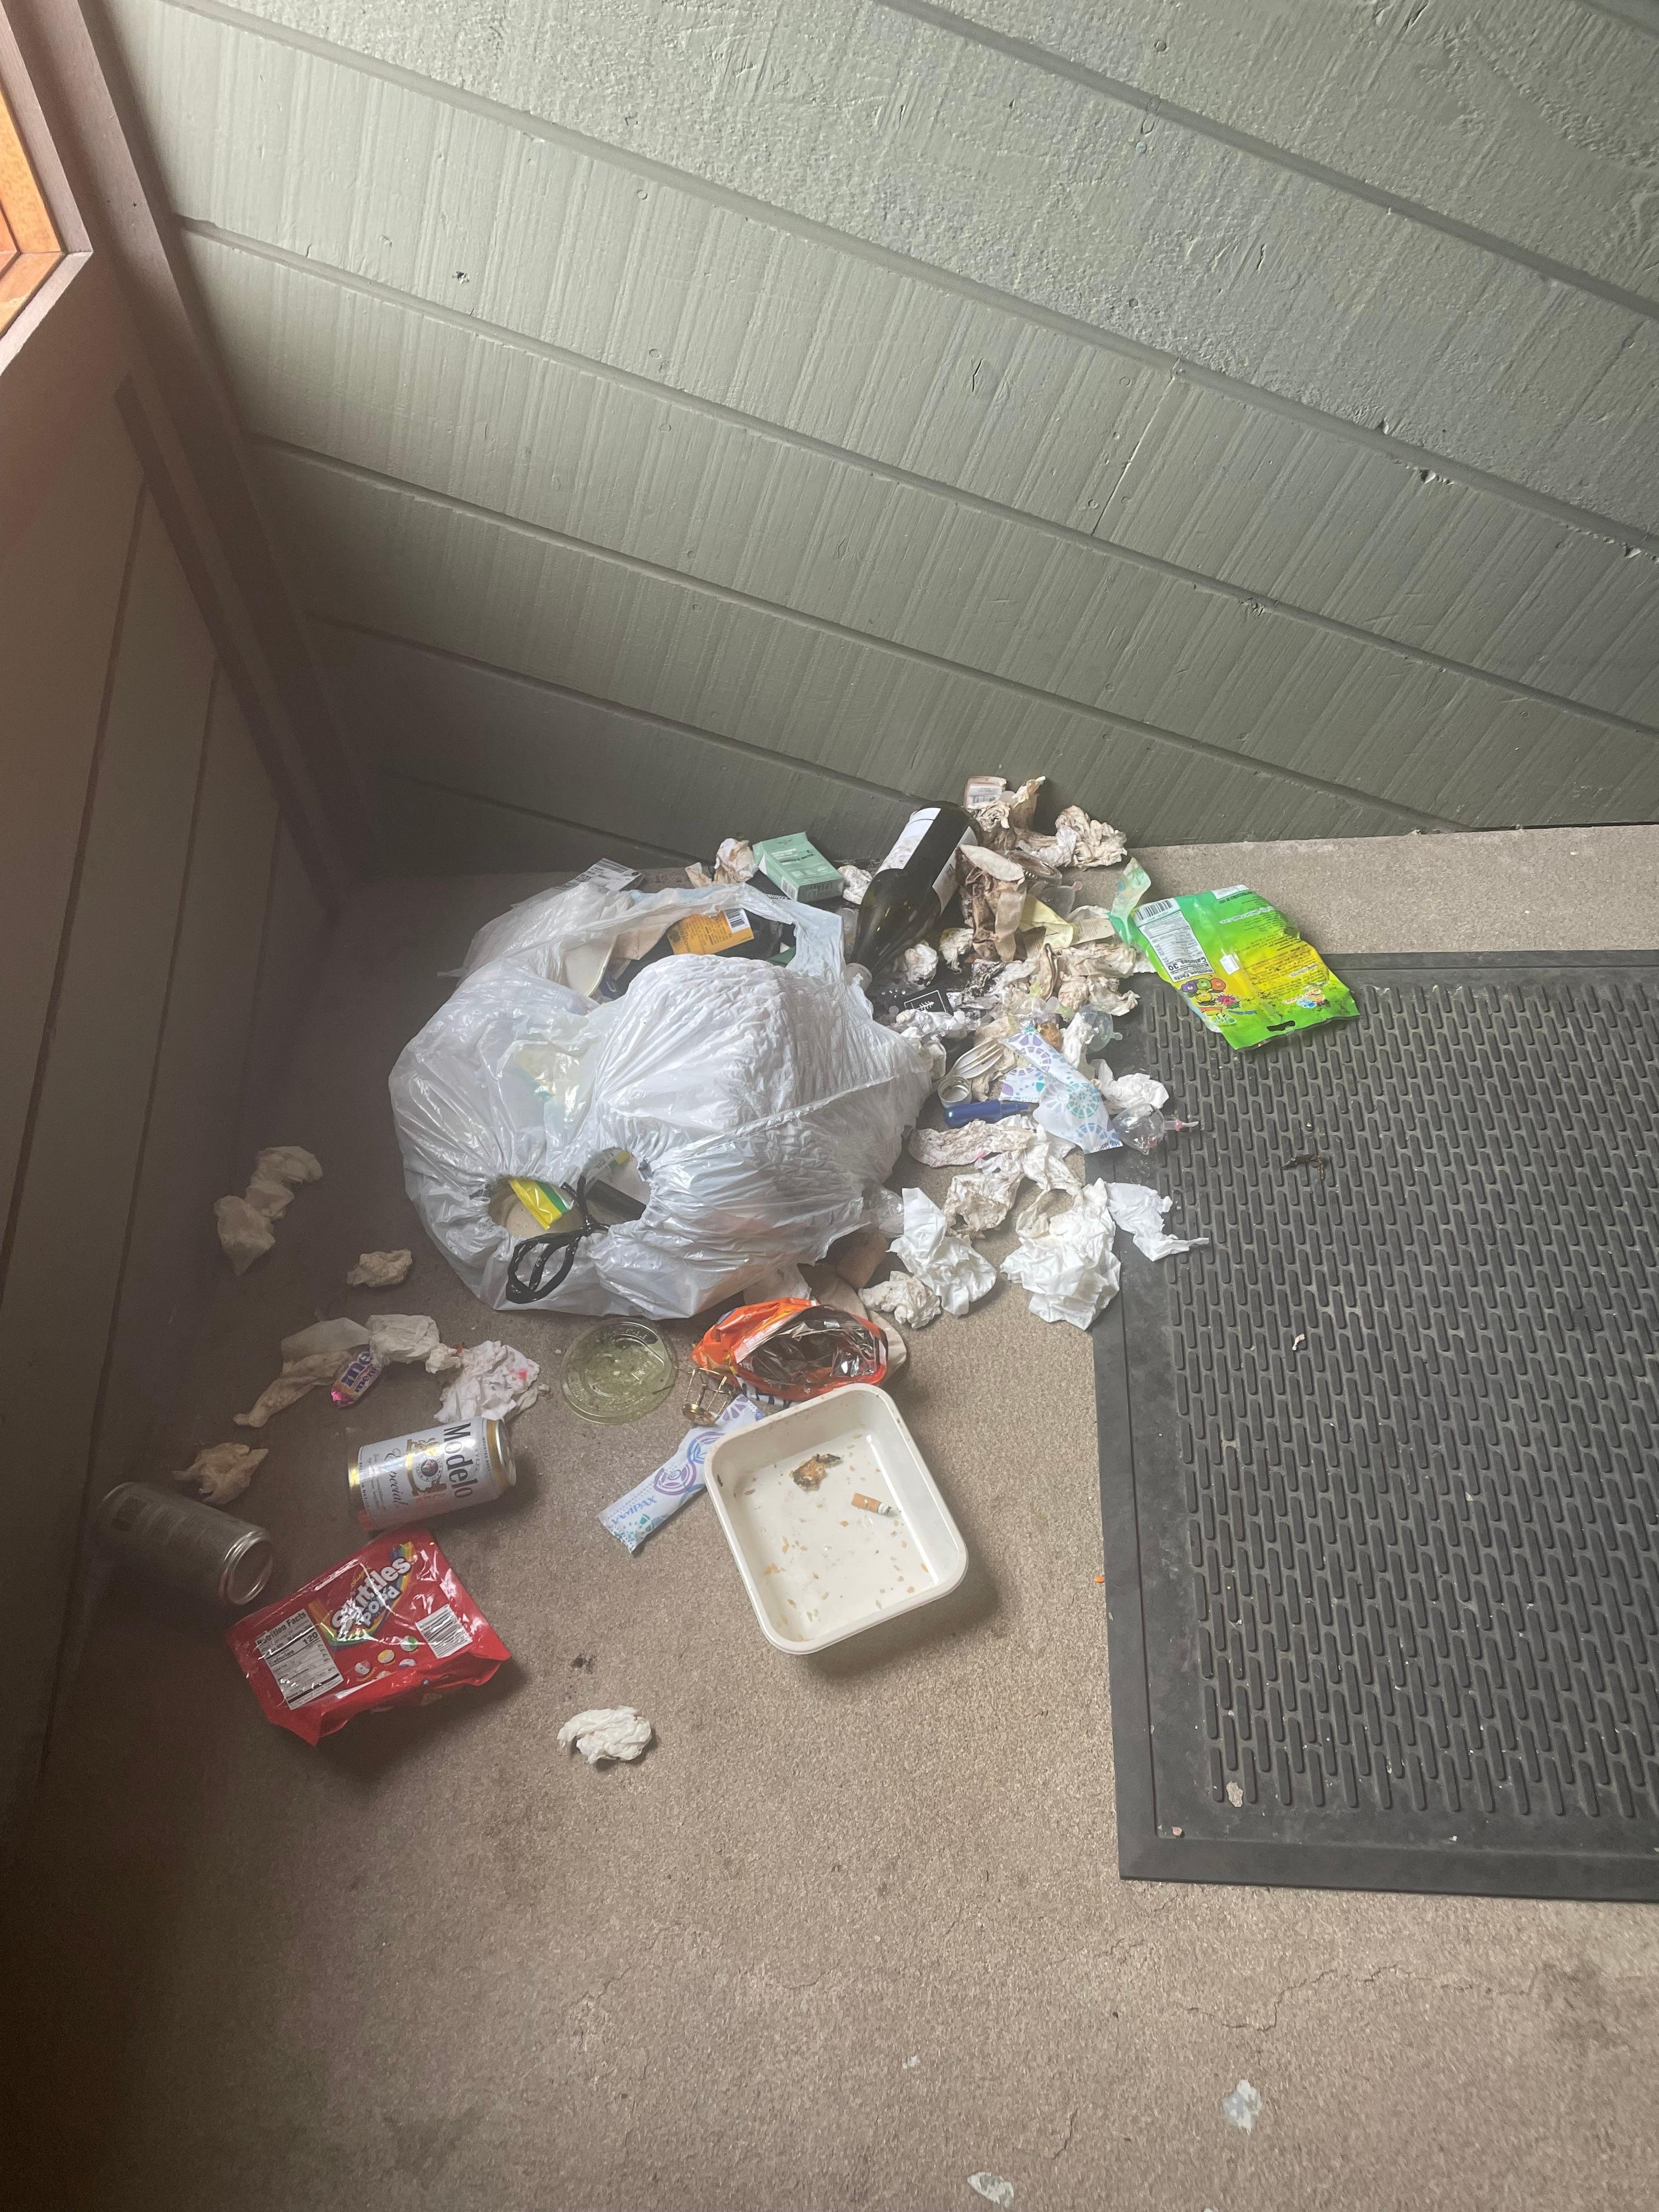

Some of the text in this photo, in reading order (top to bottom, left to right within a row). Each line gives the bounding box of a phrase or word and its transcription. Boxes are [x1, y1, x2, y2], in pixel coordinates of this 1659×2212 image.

[443, 1423, 478, 1498] Modelo
[384, 1448, 409, 1505] Epecial
[611, 1496, 658, 1525] TAMPAX
[286, 1611, 307, 1627] Facts
[302, 1632, 319, 1645] 120
[268, 1649, 295, 1666] Calories
